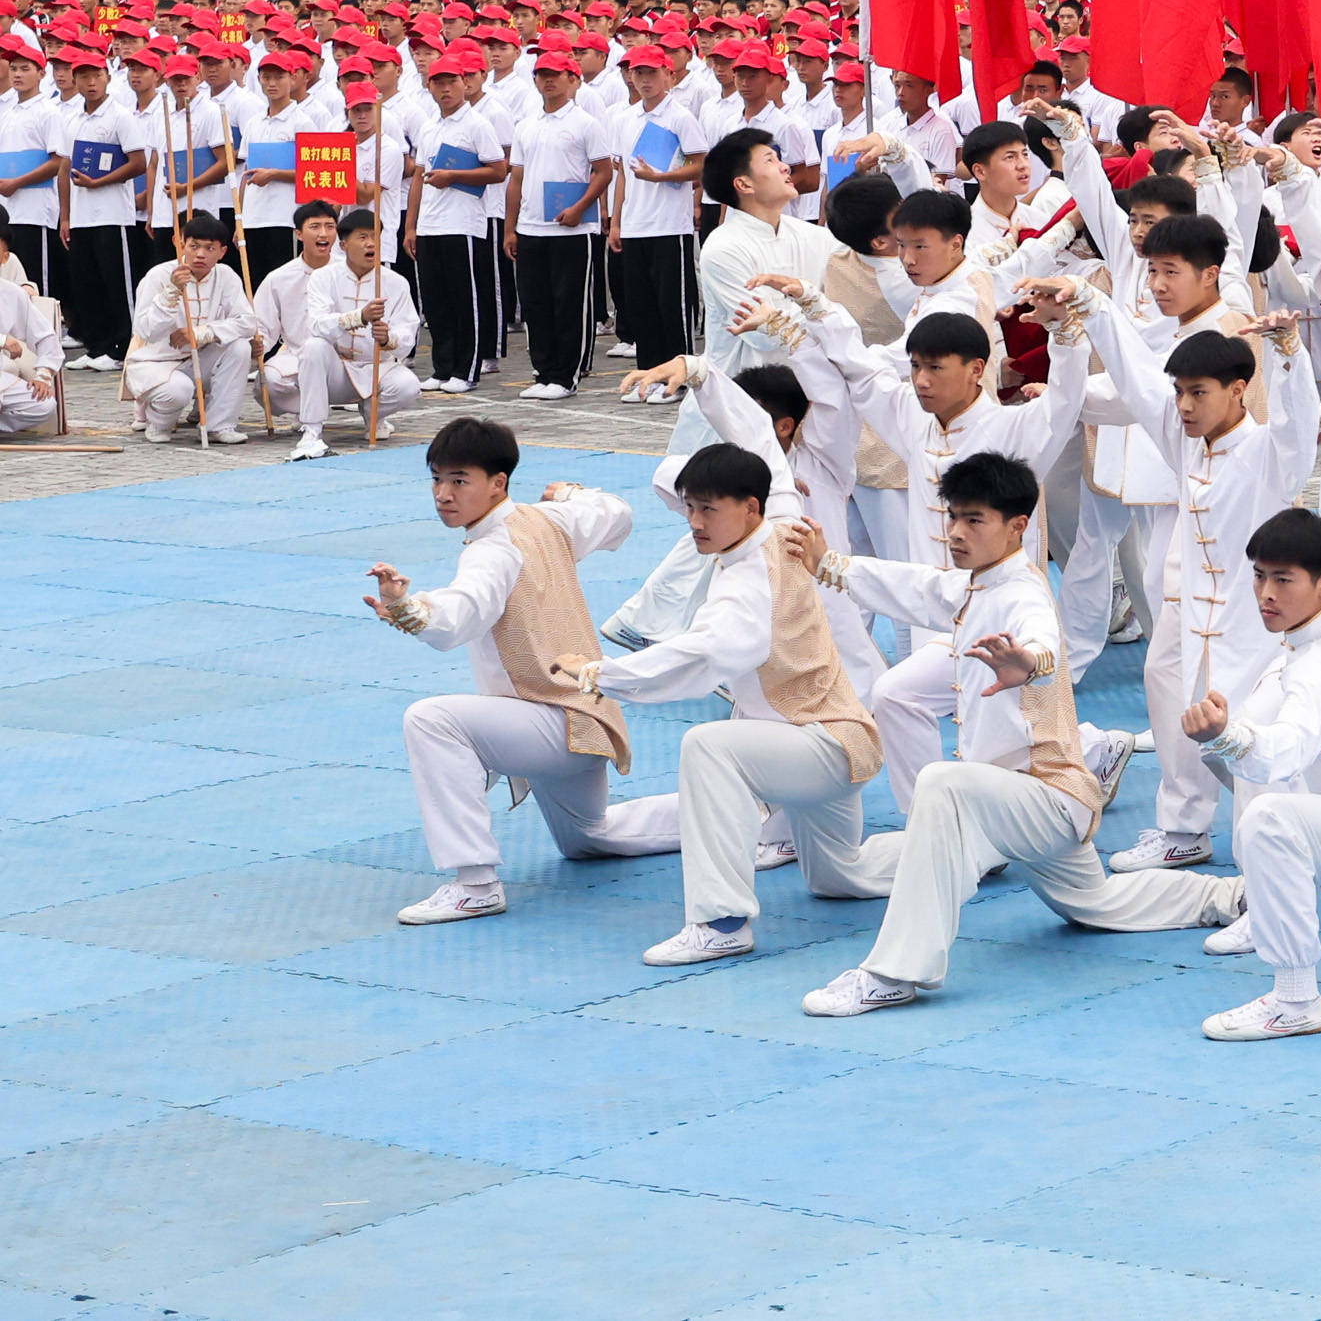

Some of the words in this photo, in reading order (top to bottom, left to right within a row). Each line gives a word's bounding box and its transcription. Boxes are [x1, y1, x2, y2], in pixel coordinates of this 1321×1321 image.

[221, 30, 244, 43] 代表队
[301, 146, 352, 161] 散打裁判员
[303, 170, 348, 189] 代表队
